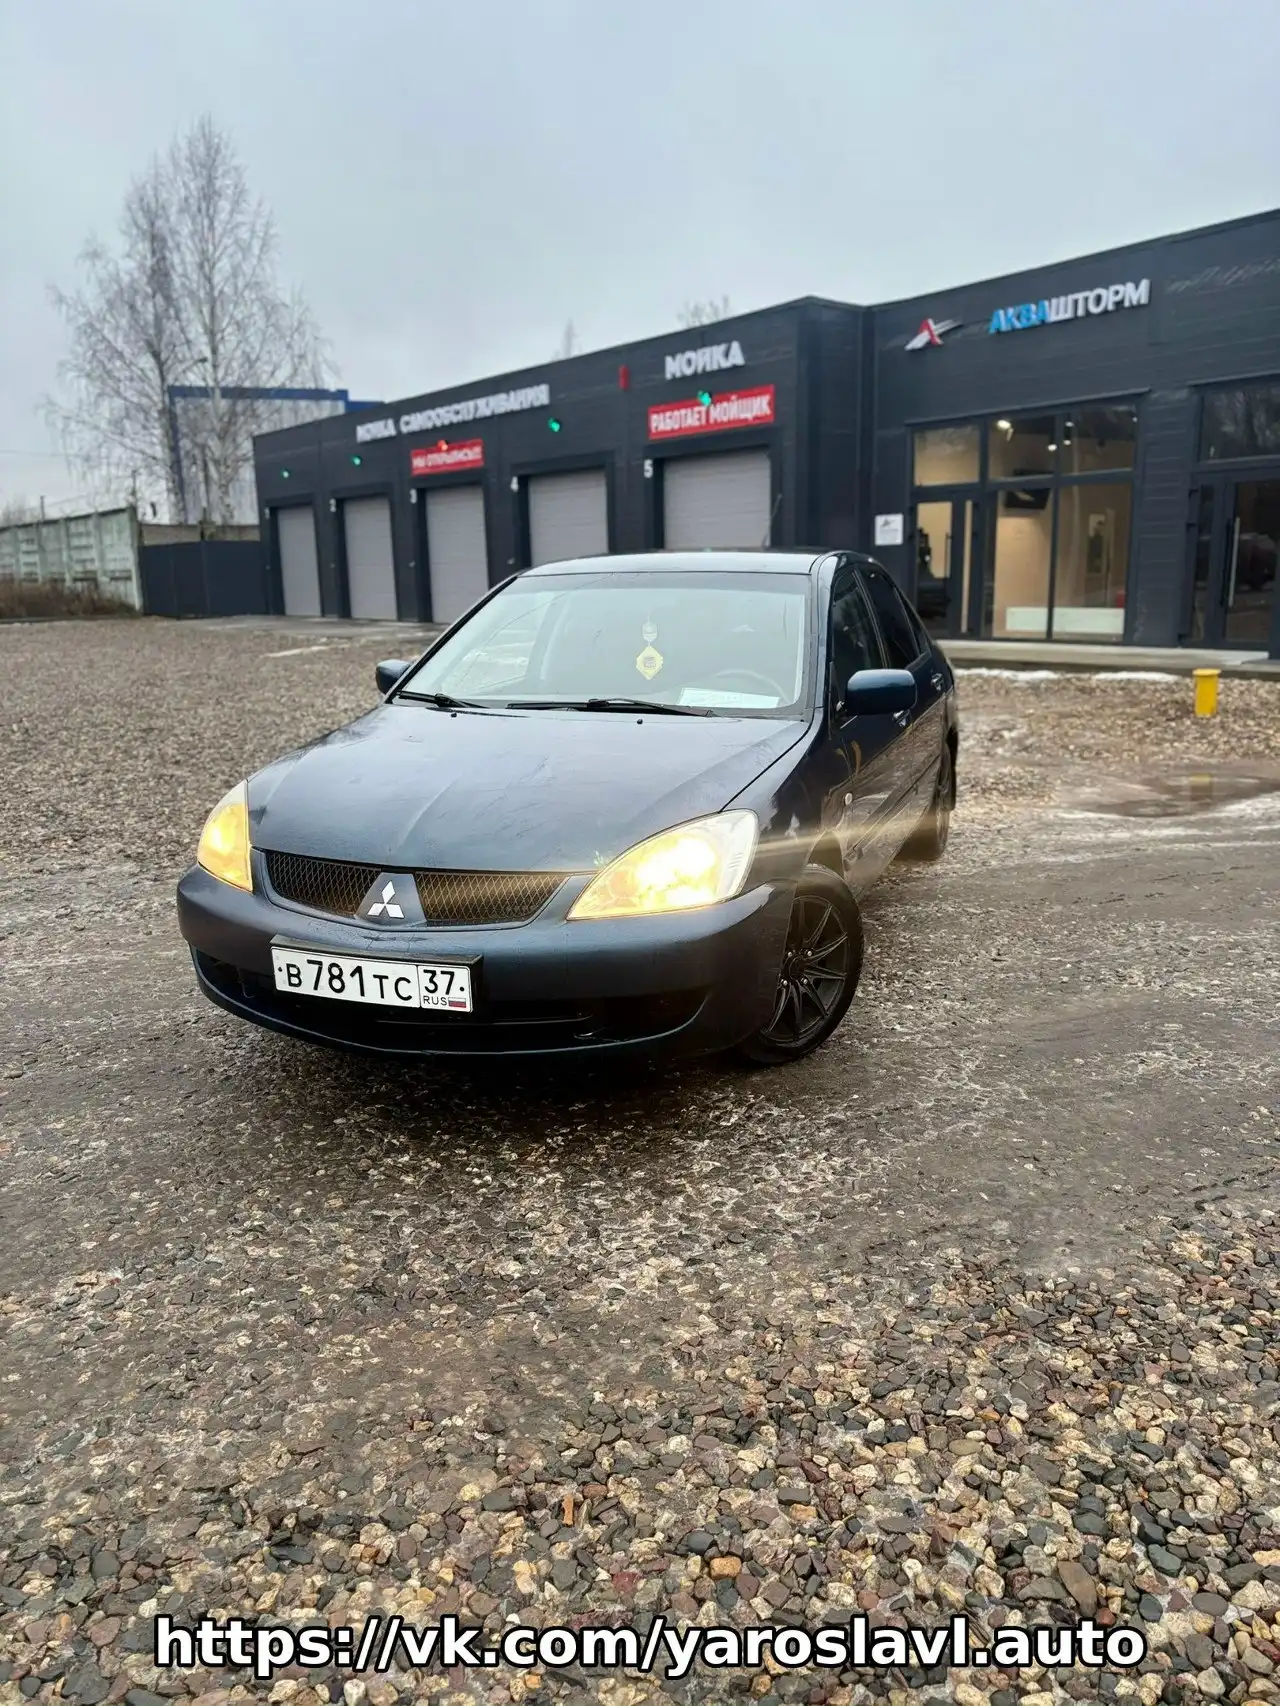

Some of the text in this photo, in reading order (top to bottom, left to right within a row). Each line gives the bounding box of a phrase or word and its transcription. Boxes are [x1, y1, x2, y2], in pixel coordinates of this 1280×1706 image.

[988, 278, 1150, 334] АКВАШТОРМ
[651, 394, 772, 433] РАБОТАЕТ МОЙЩИК
[643, 459, 654, 479] 5
[423, 969, 455, 996] 37
[422, 996, 448, 1006] RUS
